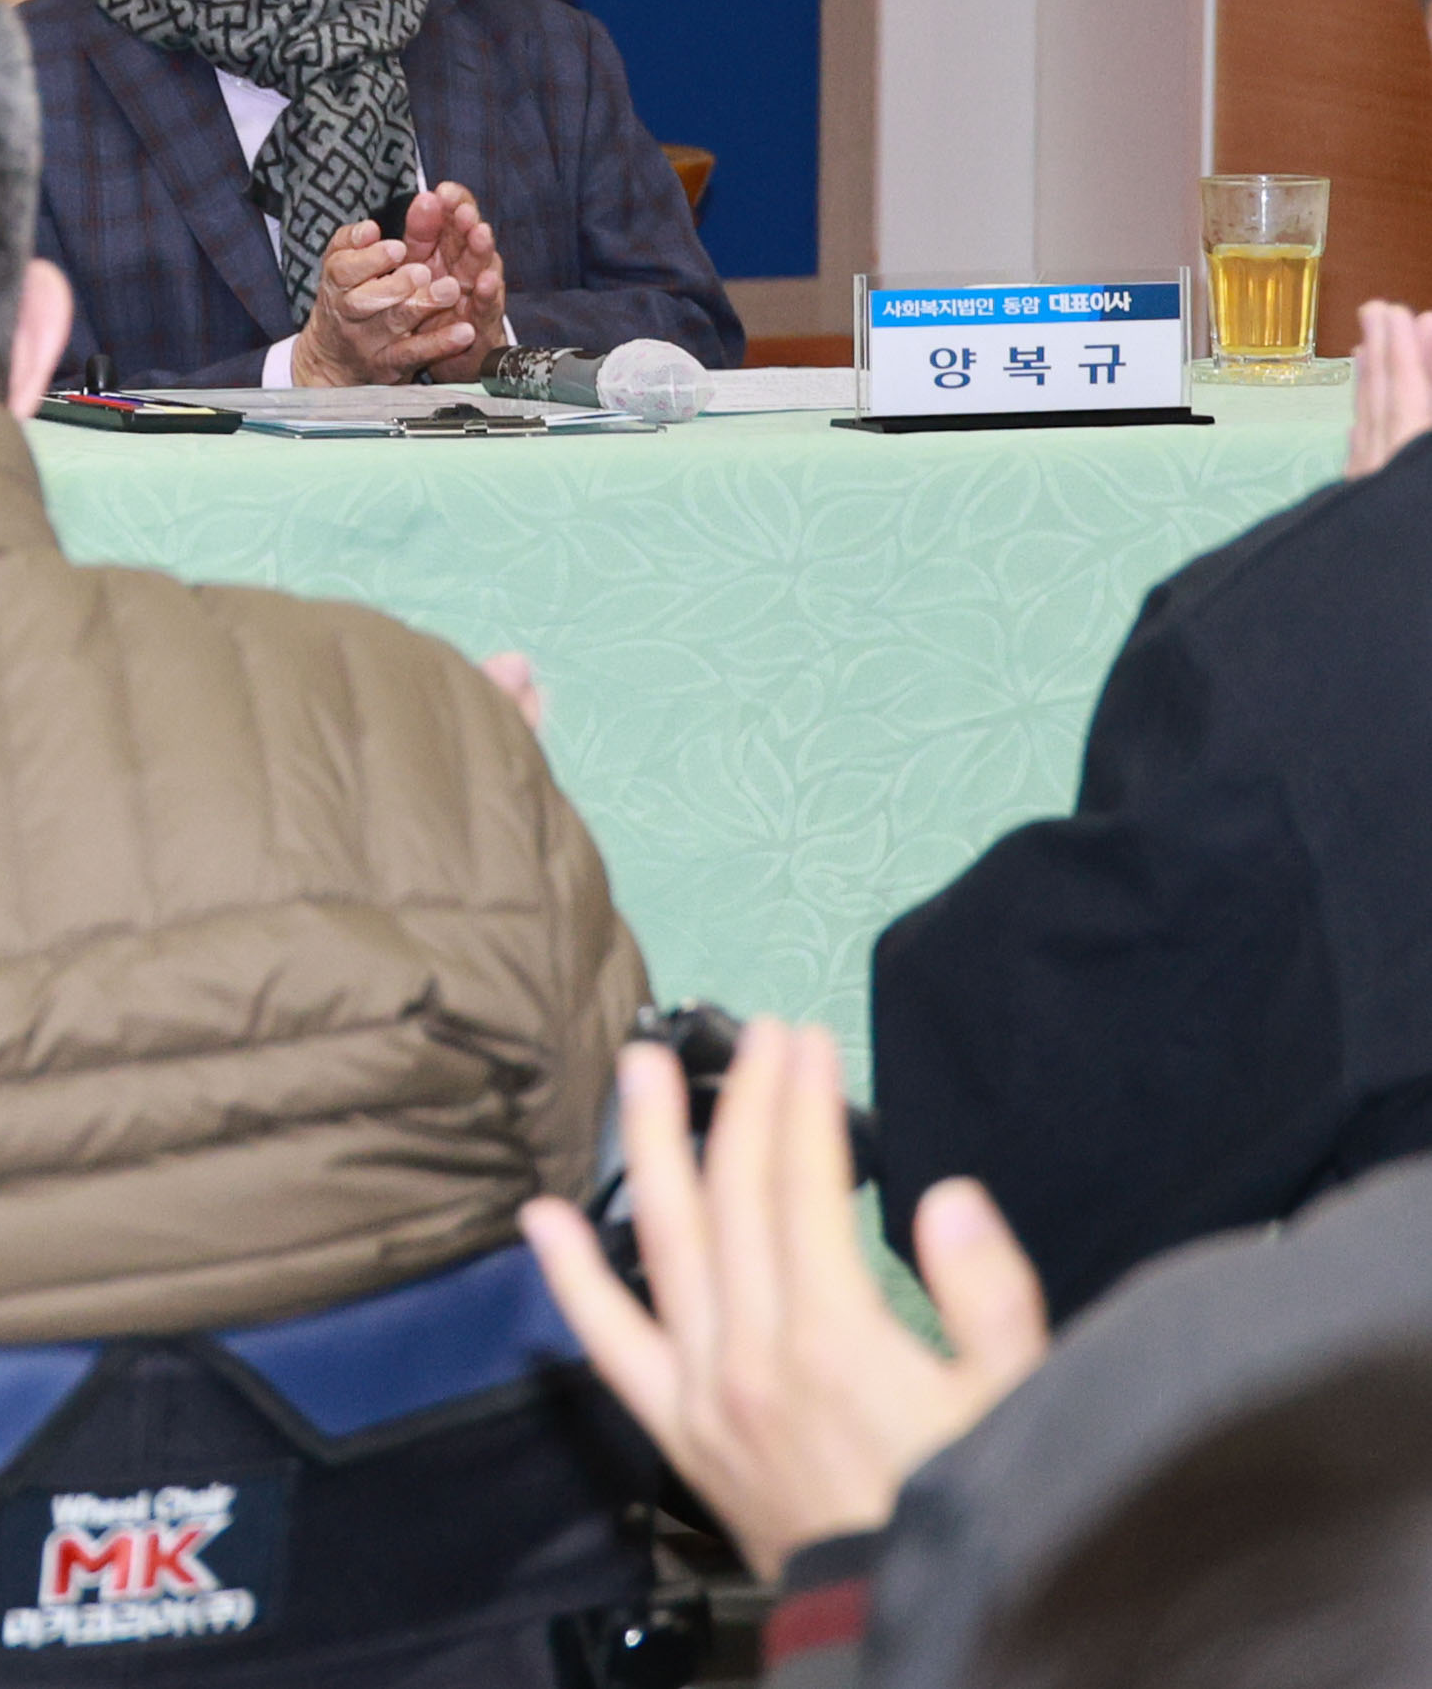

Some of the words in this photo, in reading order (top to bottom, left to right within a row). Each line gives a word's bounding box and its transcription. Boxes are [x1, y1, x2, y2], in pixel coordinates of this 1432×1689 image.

[882, 297, 995, 318] 사회복지법인
[1049, 291, 1133, 315] 대표이사
[48, 1519, 218, 1599] MK
